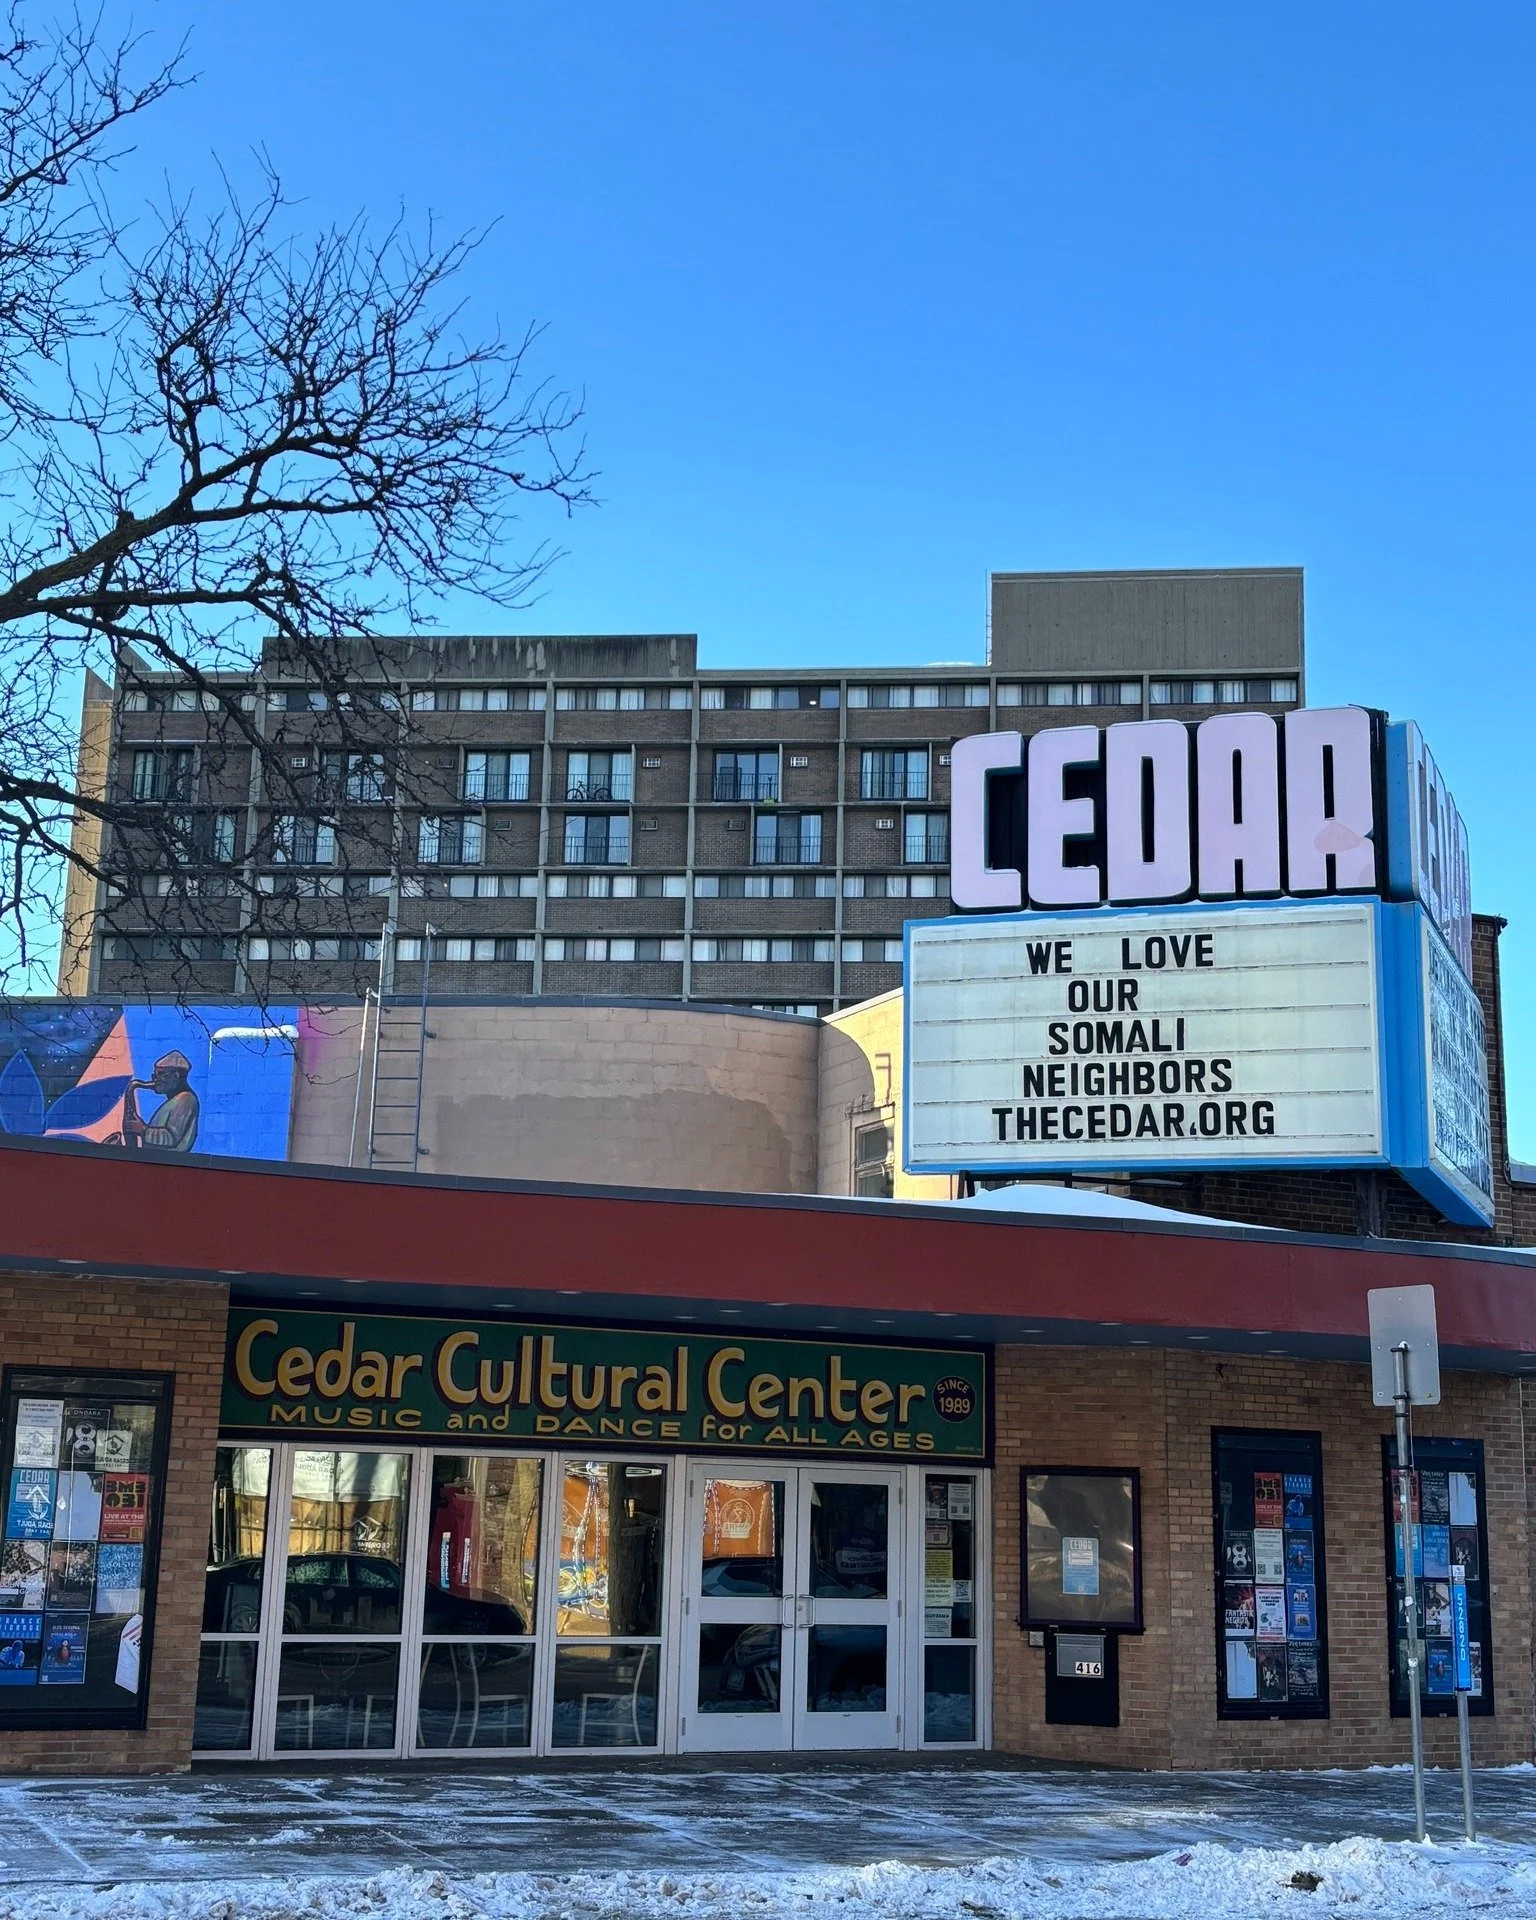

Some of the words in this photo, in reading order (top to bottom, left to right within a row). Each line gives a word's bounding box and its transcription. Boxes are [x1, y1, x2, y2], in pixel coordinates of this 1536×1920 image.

[950, 707, 1376, 908] CEDAR
[1026, 940, 1072, 974] WE
[1122, 934, 1213, 970] LOVE
[1068, 979, 1138, 1012] OUR
[1048, 1018, 1185, 1055] SOMALI
[1023, 1058, 1232, 1097] NEIGHBORS
[234, 1318, 423, 1399] Cedar
[435, 1331, 688, 1413] Cultural
[706, 1347, 926, 1425] Center
[937, 1379, 970, 1394] SINCE
[938, 1397, 971, 1414] 1989
[270, 1404, 422, 1426] MUSIC
[446, 1404, 509, 1430] and
[536, 1415, 681, 1437] DANCE
[702, 1414, 752, 1440] for
[763, 1426, 827, 1443] ALL
[840, 1429, 934, 1450] AGES
[1457, 1594, 1466, 1661] 52820
[1076, 1662, 1100, 1674] 416
